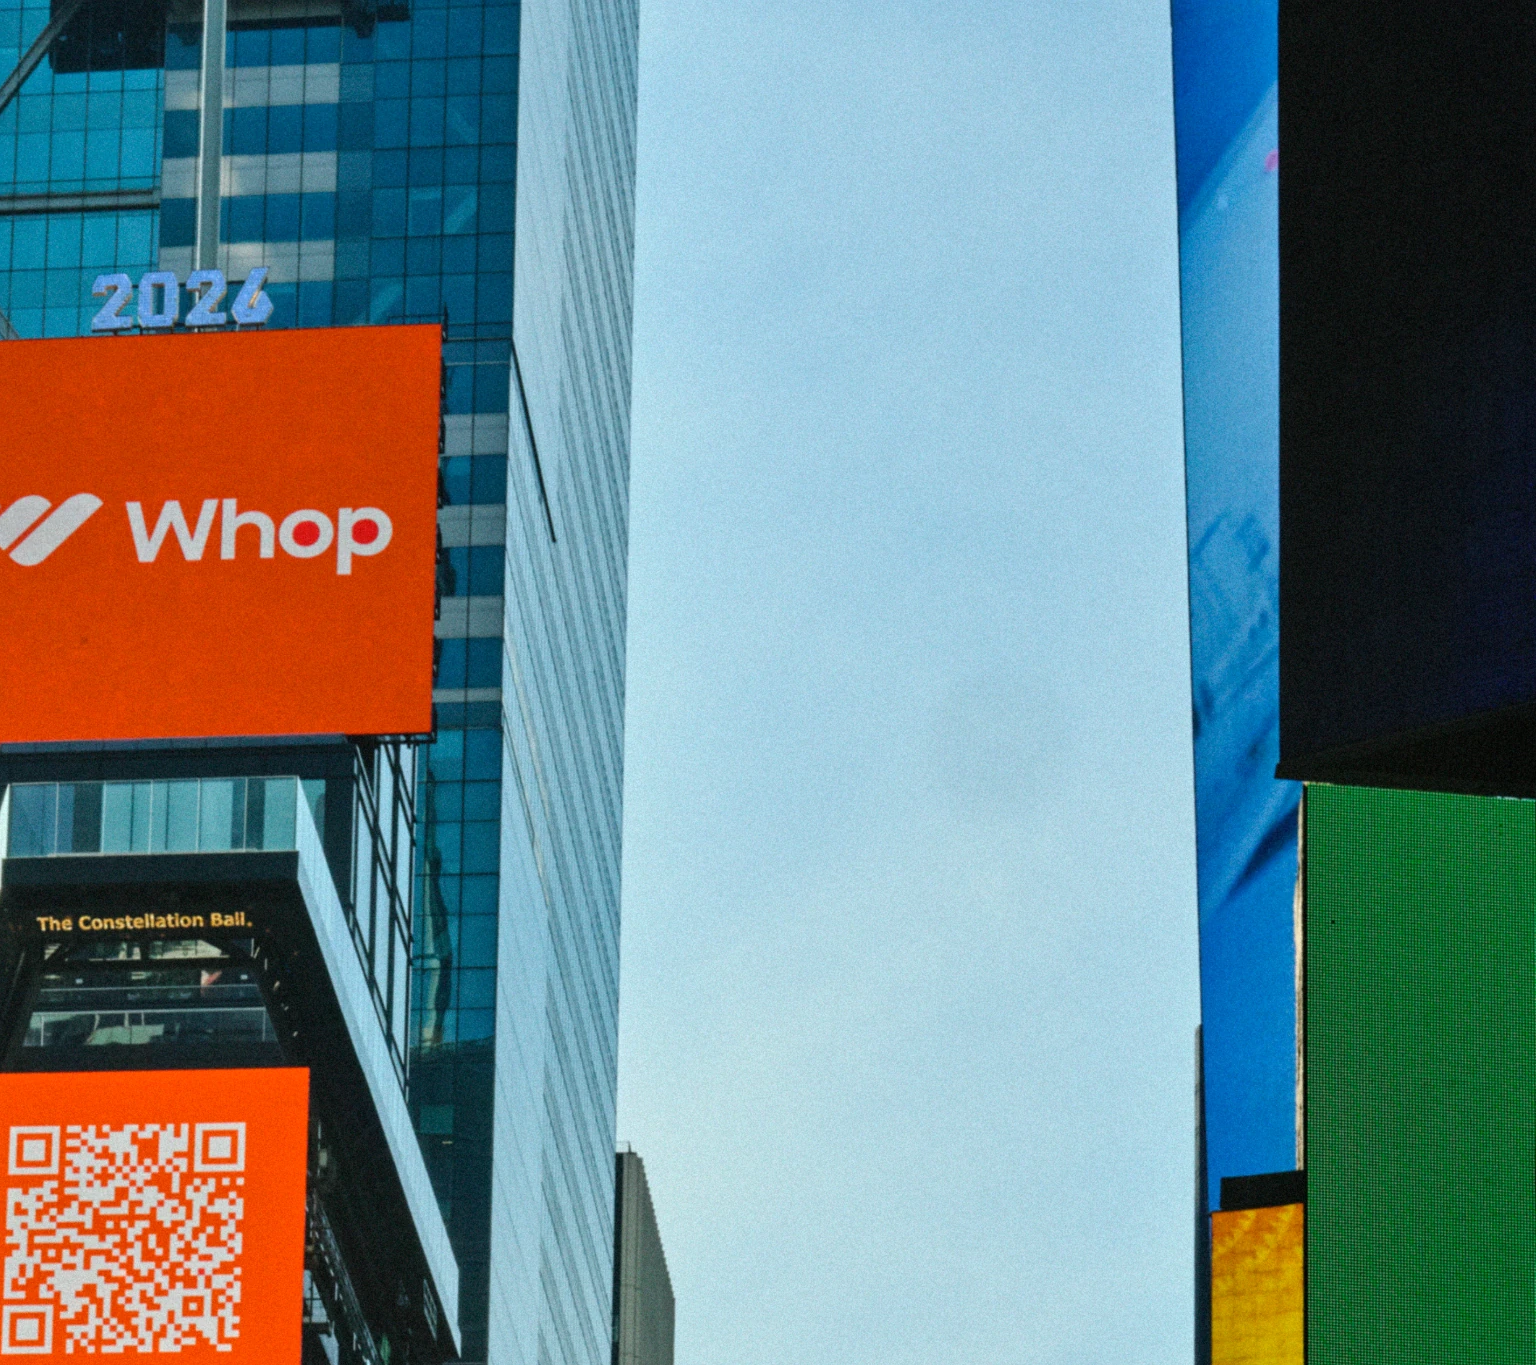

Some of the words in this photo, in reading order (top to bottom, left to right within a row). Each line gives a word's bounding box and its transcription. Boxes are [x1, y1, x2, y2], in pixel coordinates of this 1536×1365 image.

[91, 267, 274, 330] 2026
[126, 498, 393, 576] Whop
[36, 916, 73, 932] The
[78, 913, 205, 930] Constellation
[210, 911, 253, 928] Ball.
